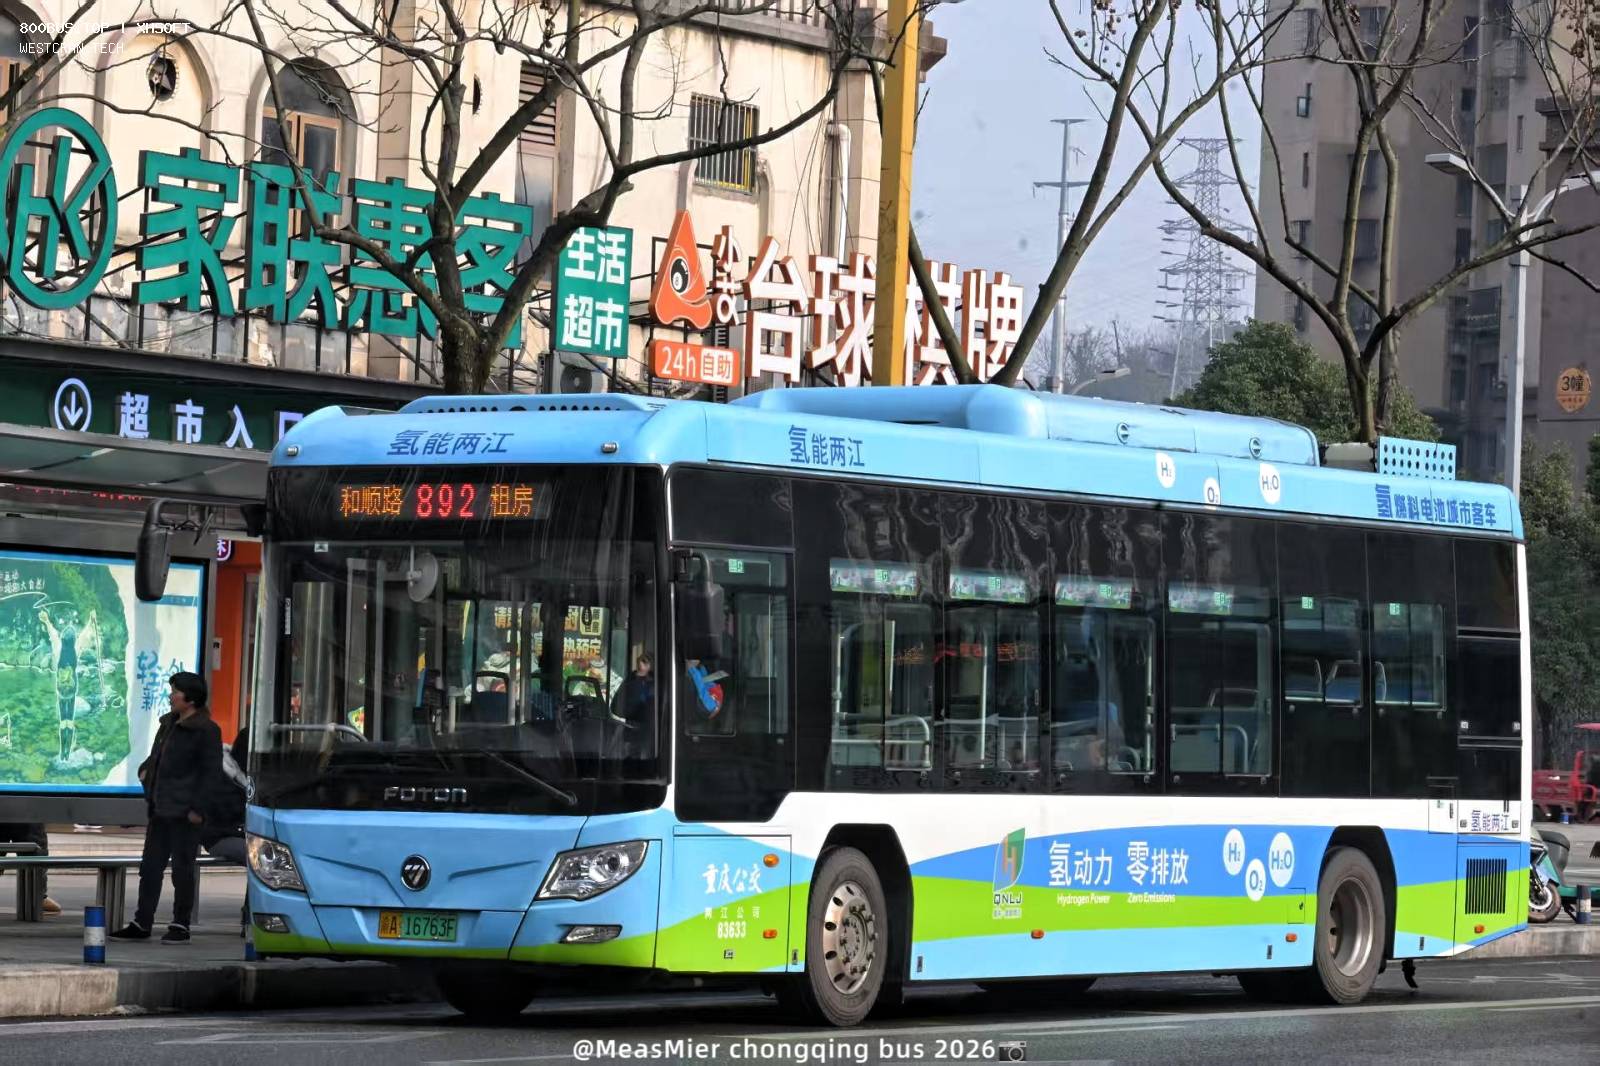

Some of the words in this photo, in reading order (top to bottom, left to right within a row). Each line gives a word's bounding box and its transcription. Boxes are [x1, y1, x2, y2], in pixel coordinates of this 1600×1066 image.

[133, 147, 533, 348] 家联惠客
[565, 226, 626, 284] 生活
[561, 296, 623, 351] 超市
[743, 236, 1024, 385] 台球棋牌
[387, 430, 514, 456] 氢能两江
[788, 424, 865, 467] 氢能两江
[340, 486, 403, 517] 和顺路
[415, 483, 477, 518] 892
[490, 484, 534, 517] 租房
[1375, 483, 1497, 527] 氢燃料电池城市客车
[384, 787, 467, 802] FOTON
[1049, 840, 1113, 886] 氢动力
[1126, 841, 1189, 886] 零排放
[993, 893, 1022, 905] QNLJ
